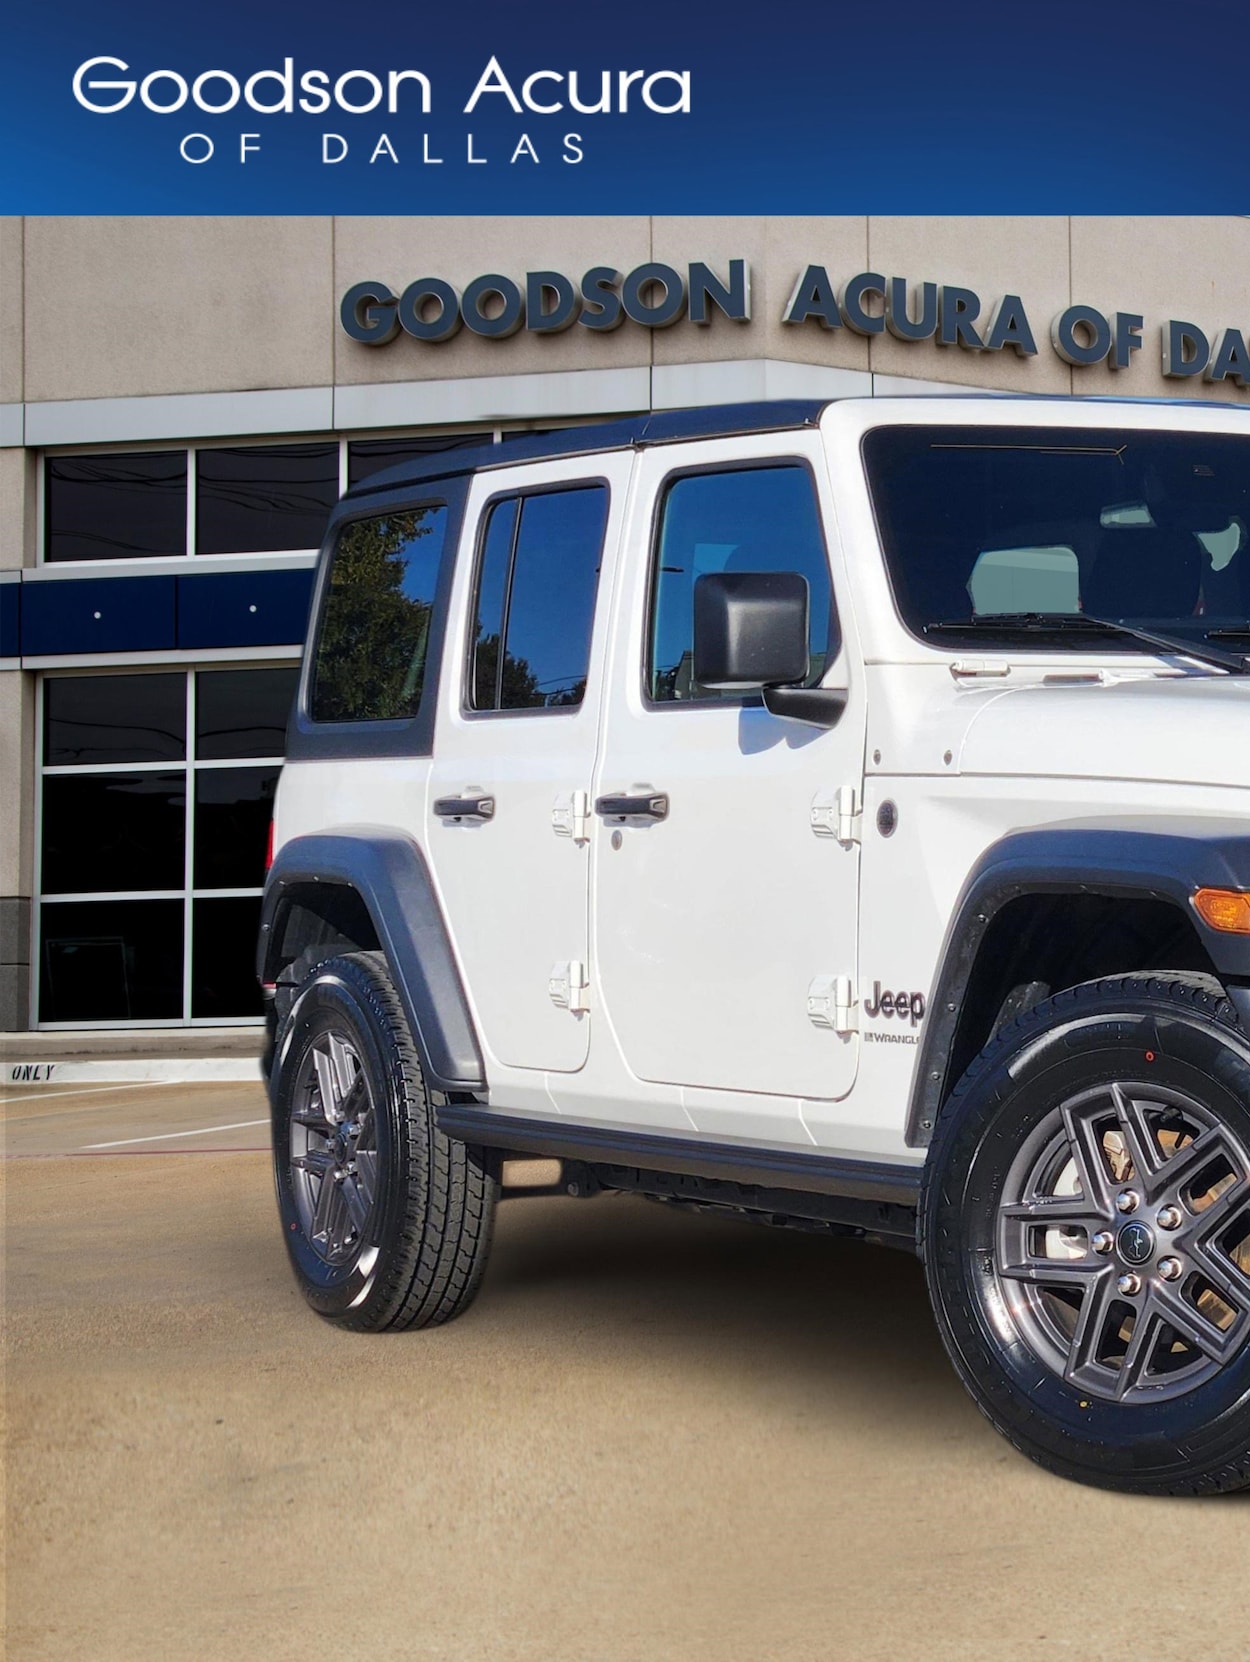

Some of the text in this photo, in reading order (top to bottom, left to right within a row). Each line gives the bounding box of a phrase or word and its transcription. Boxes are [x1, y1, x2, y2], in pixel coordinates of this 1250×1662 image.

[340, 259, 751, 345] GOODSON
[782, 265, 1037, 357] ACURA
[1052, 306, 1144, 370] OF
[864, 980, 925, 1028] Jeep
[12, 1064, 55, 1080] ONLY
